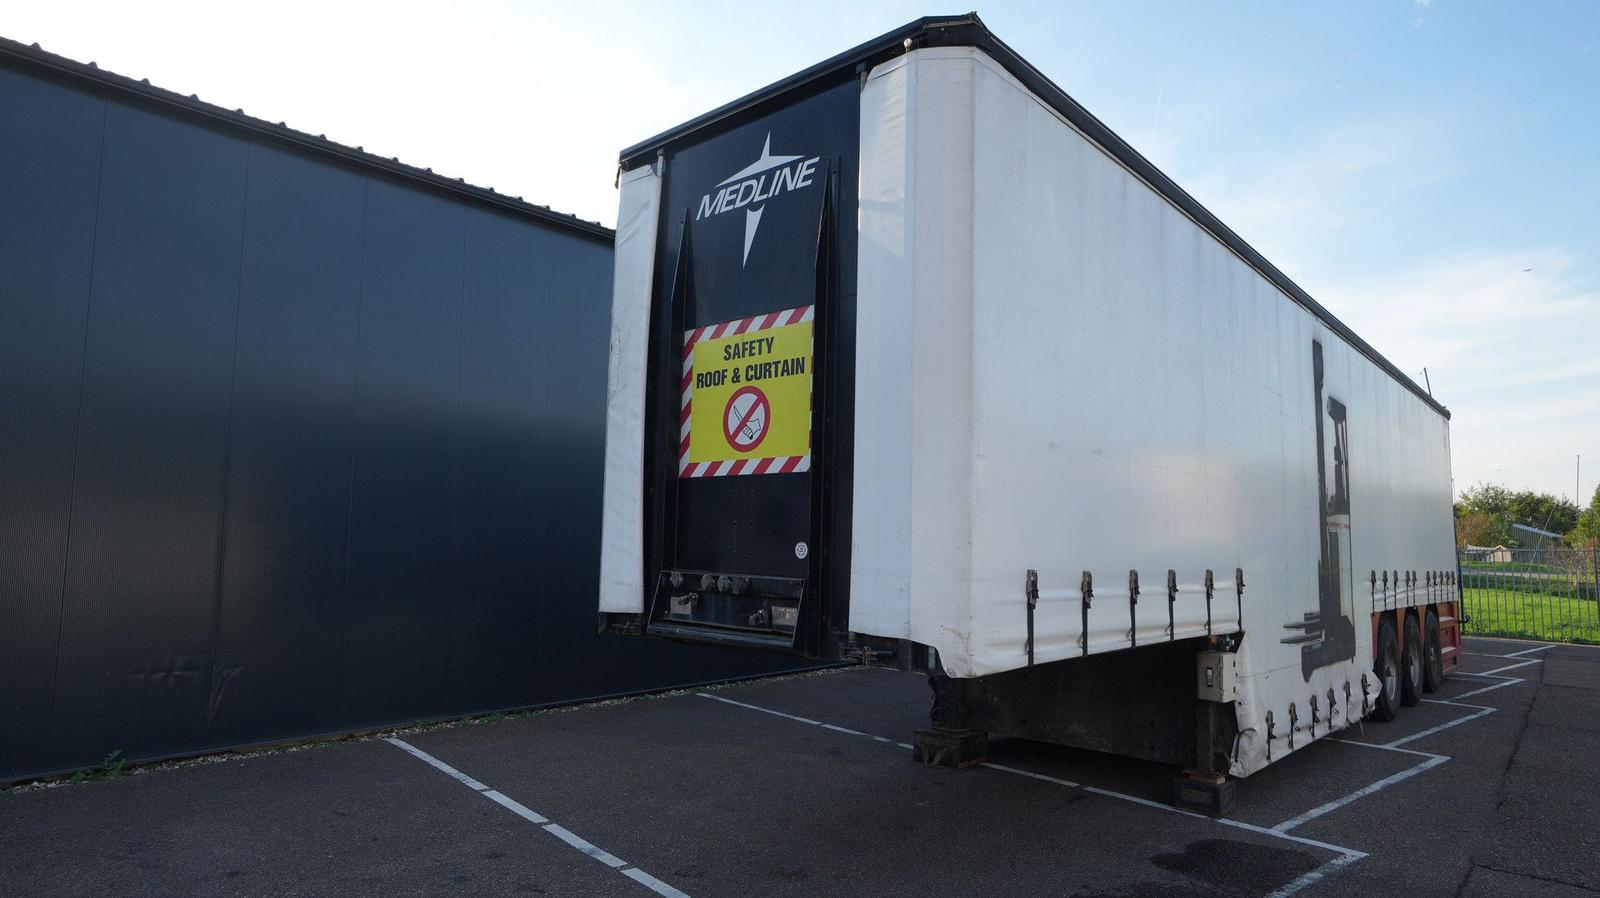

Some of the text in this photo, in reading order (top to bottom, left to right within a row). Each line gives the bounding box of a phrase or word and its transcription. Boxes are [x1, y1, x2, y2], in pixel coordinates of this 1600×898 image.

[696, 156, 820, 221] MEDLINE
[723, 336, 775, 361] SAFETY
[696, 356, 806, 389] ROOF & CURTAIN
